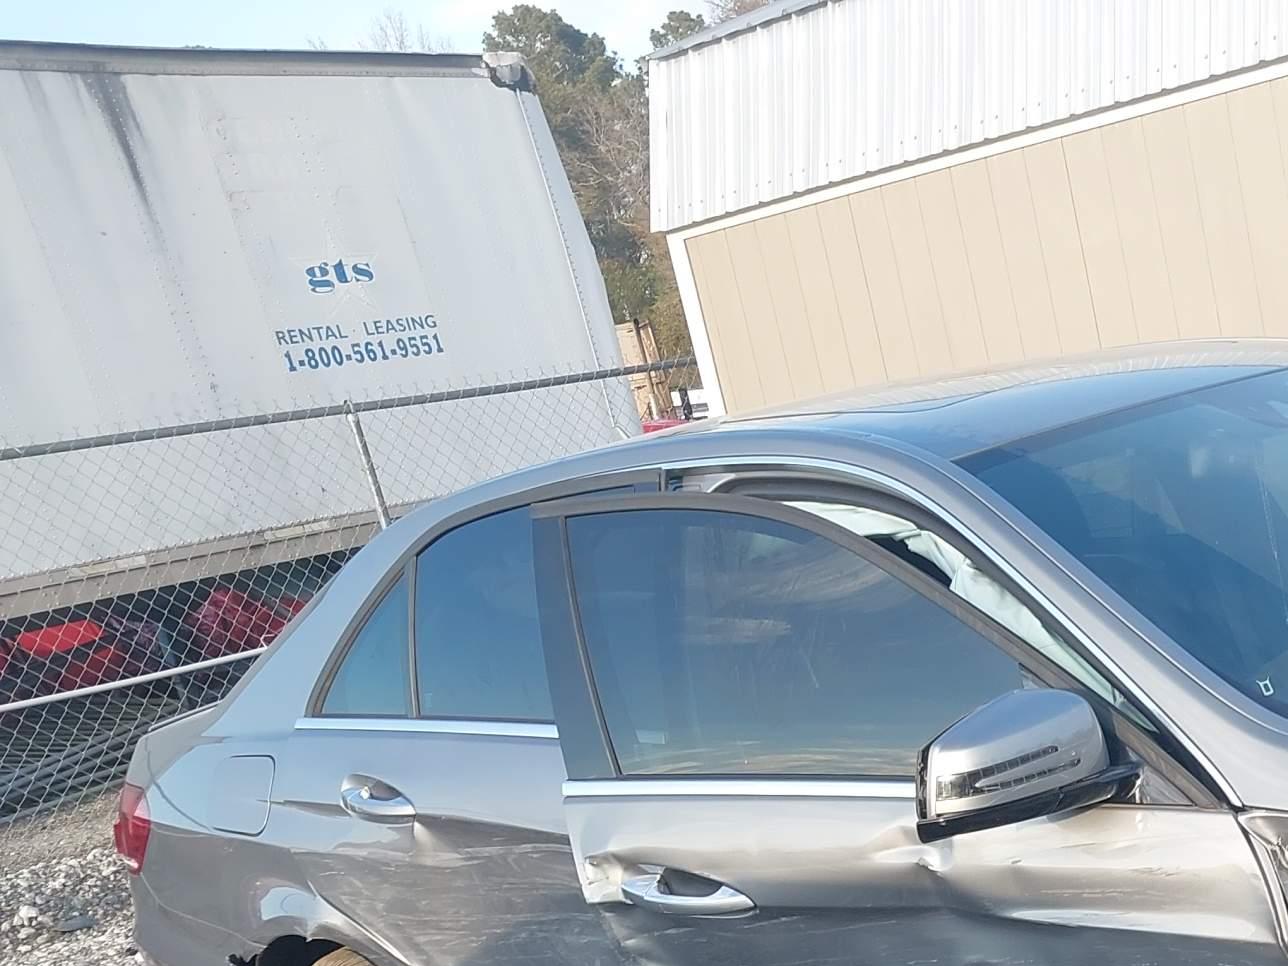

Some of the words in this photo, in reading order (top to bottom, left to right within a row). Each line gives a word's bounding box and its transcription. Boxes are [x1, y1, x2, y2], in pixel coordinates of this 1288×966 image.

[304, 258, 375, 294] gts
[275, 325, 348, 345] RENTAL
[363, 315, 437, 336] LEASING
[284, 333, 444, 372] 1-800-561-9551
